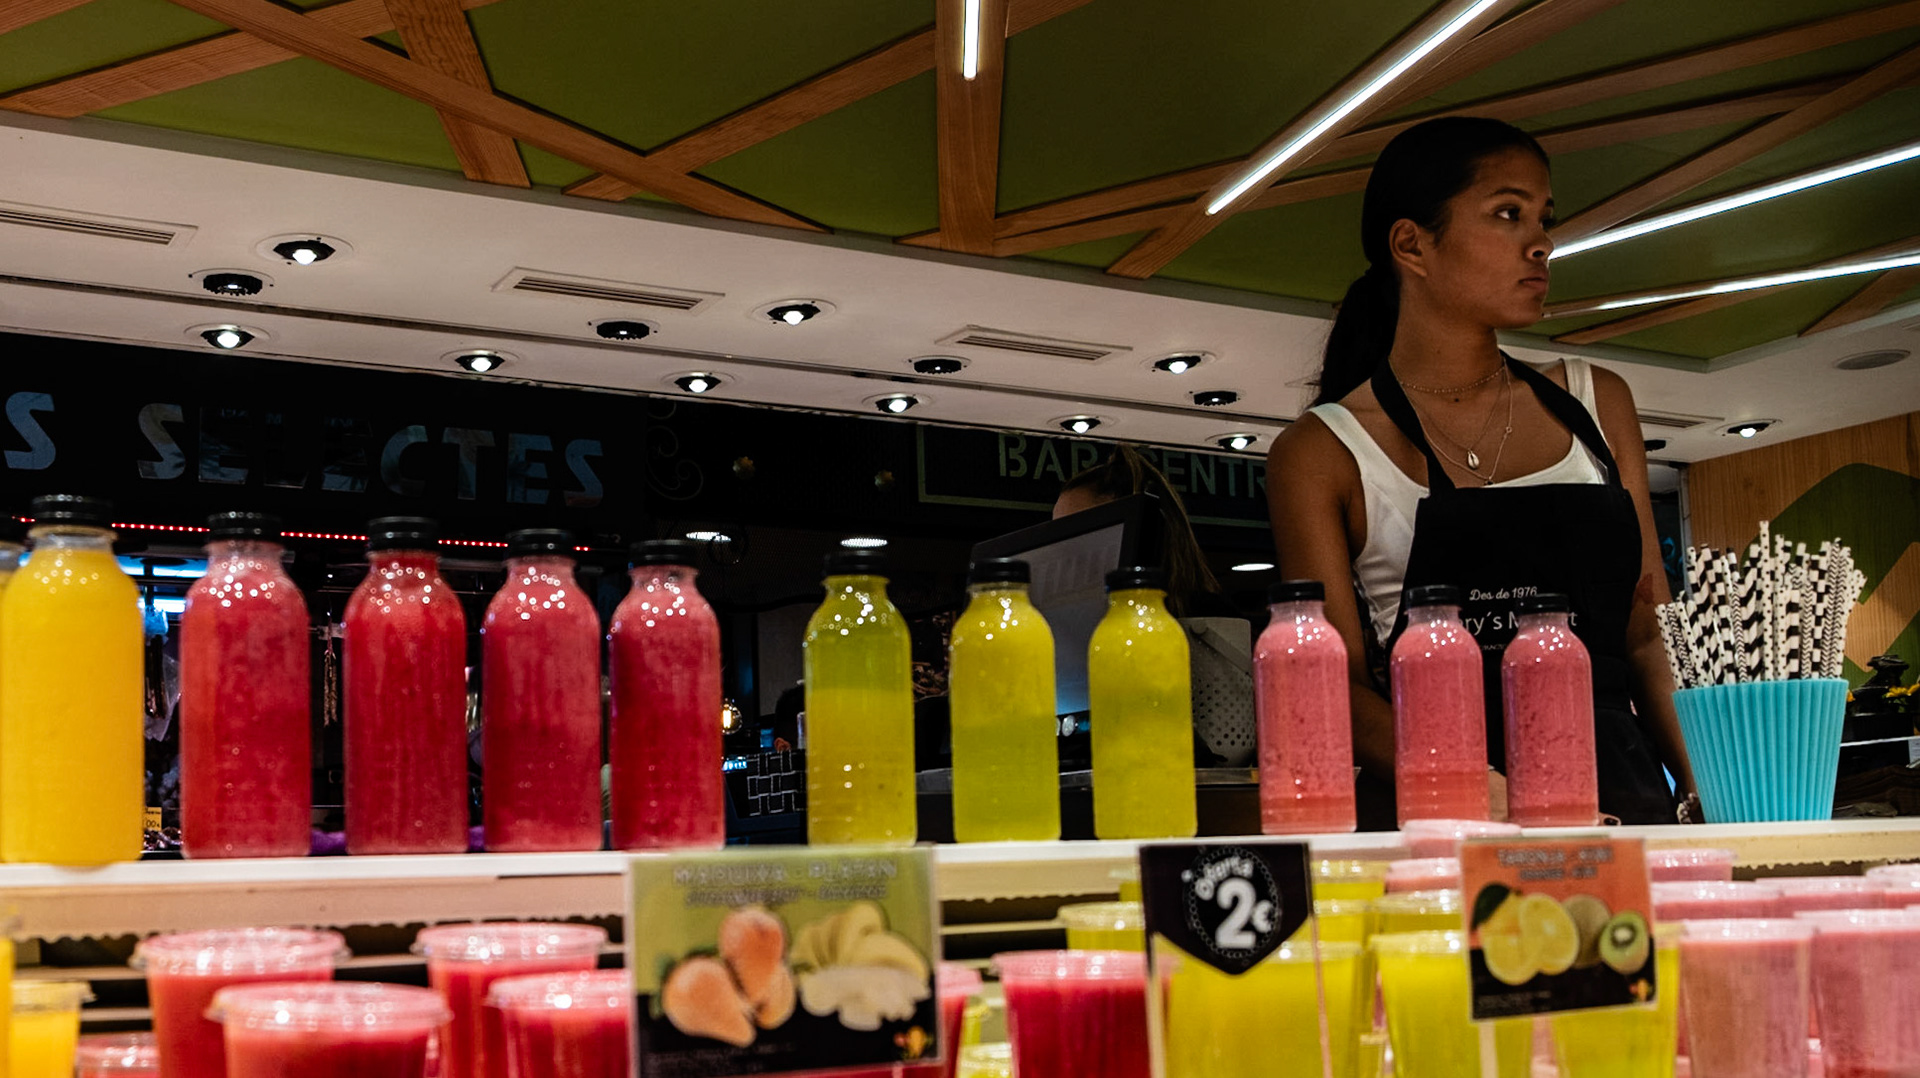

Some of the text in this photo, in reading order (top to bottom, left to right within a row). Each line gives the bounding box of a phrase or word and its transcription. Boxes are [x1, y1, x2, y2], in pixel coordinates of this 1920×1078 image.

[136, 401, 605, 509] SELECTES
[998, 432, 1099, 482] BAR
[1468, 585, 1538, 602] Des de 1976
